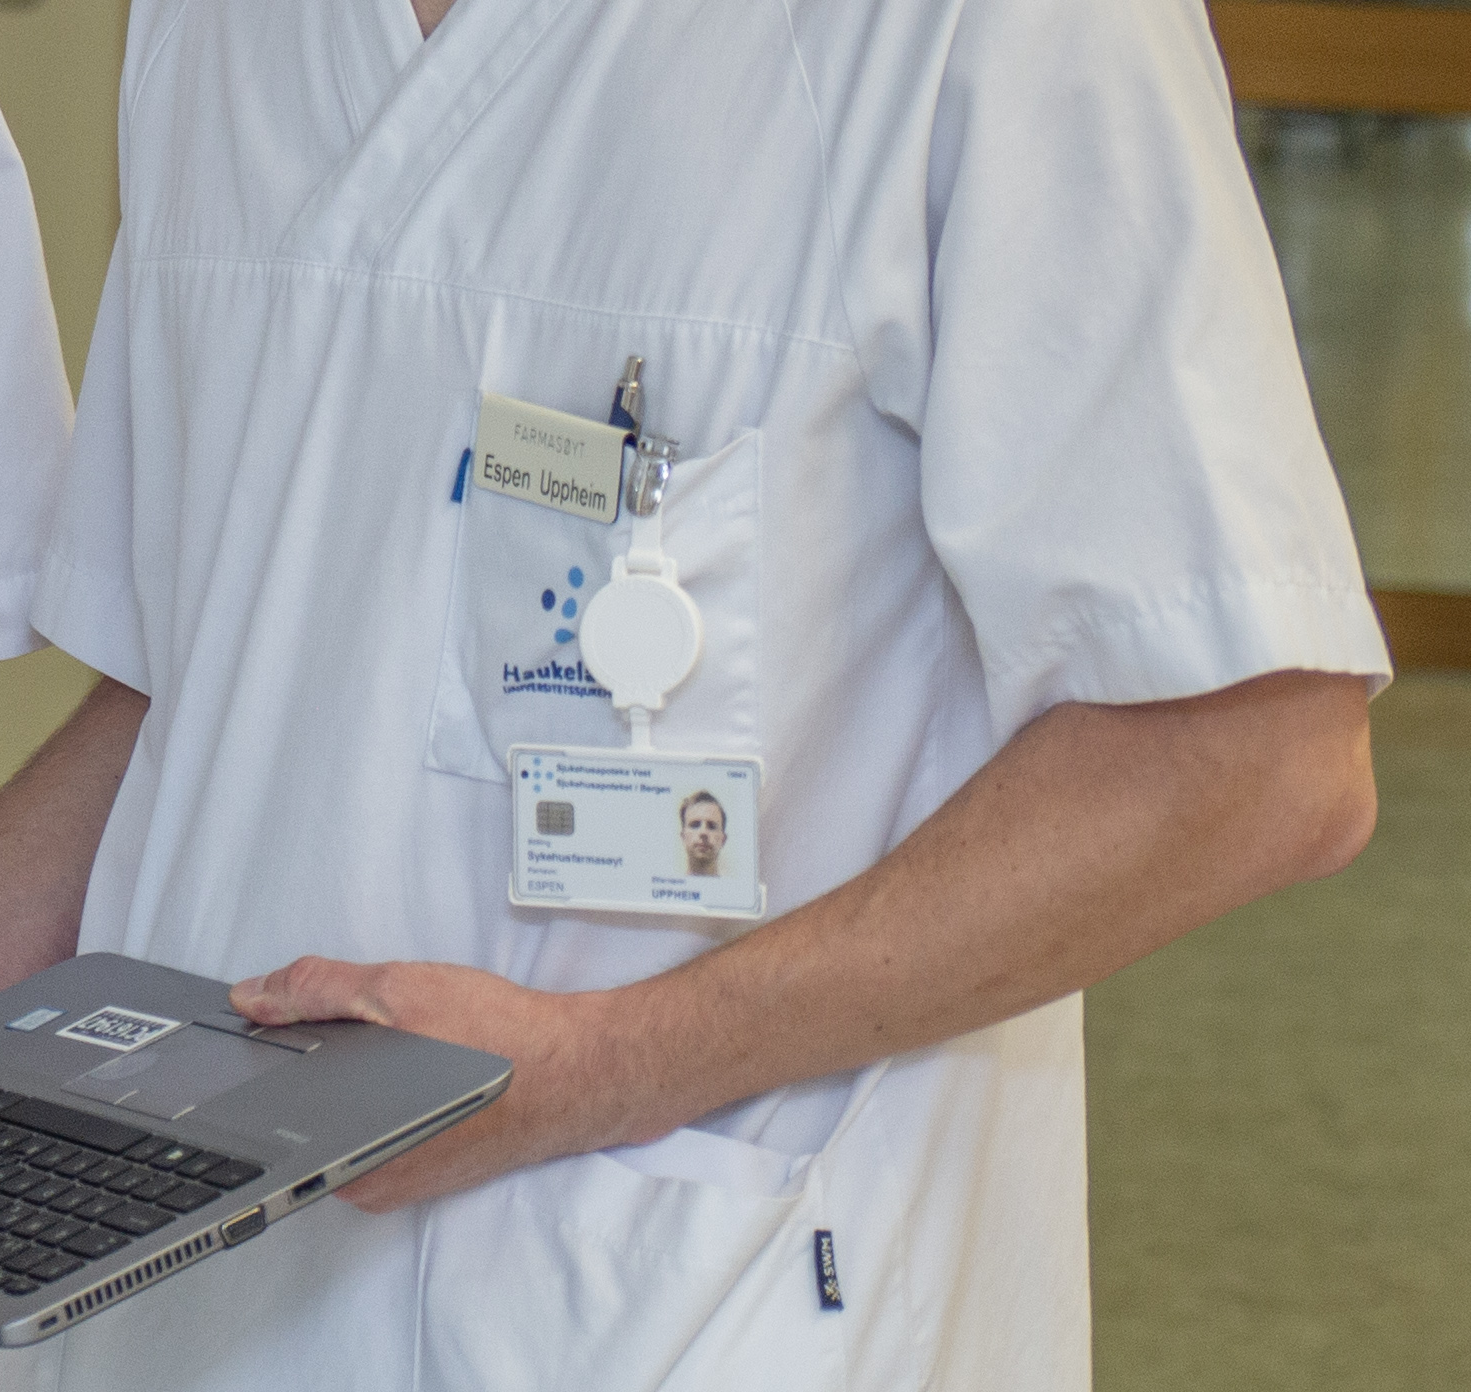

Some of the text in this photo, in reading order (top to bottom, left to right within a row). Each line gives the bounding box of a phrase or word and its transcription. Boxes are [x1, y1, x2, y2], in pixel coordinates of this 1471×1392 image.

[513, 424, 586, 457] FARMASØYT
[484, 454, 607, 512] Espen Uppheim
[640, 783, 671, 795] Bergen
[527, 880, 564, 893] ESPEN
[651, 889, 701, 901] UPPHEIM
